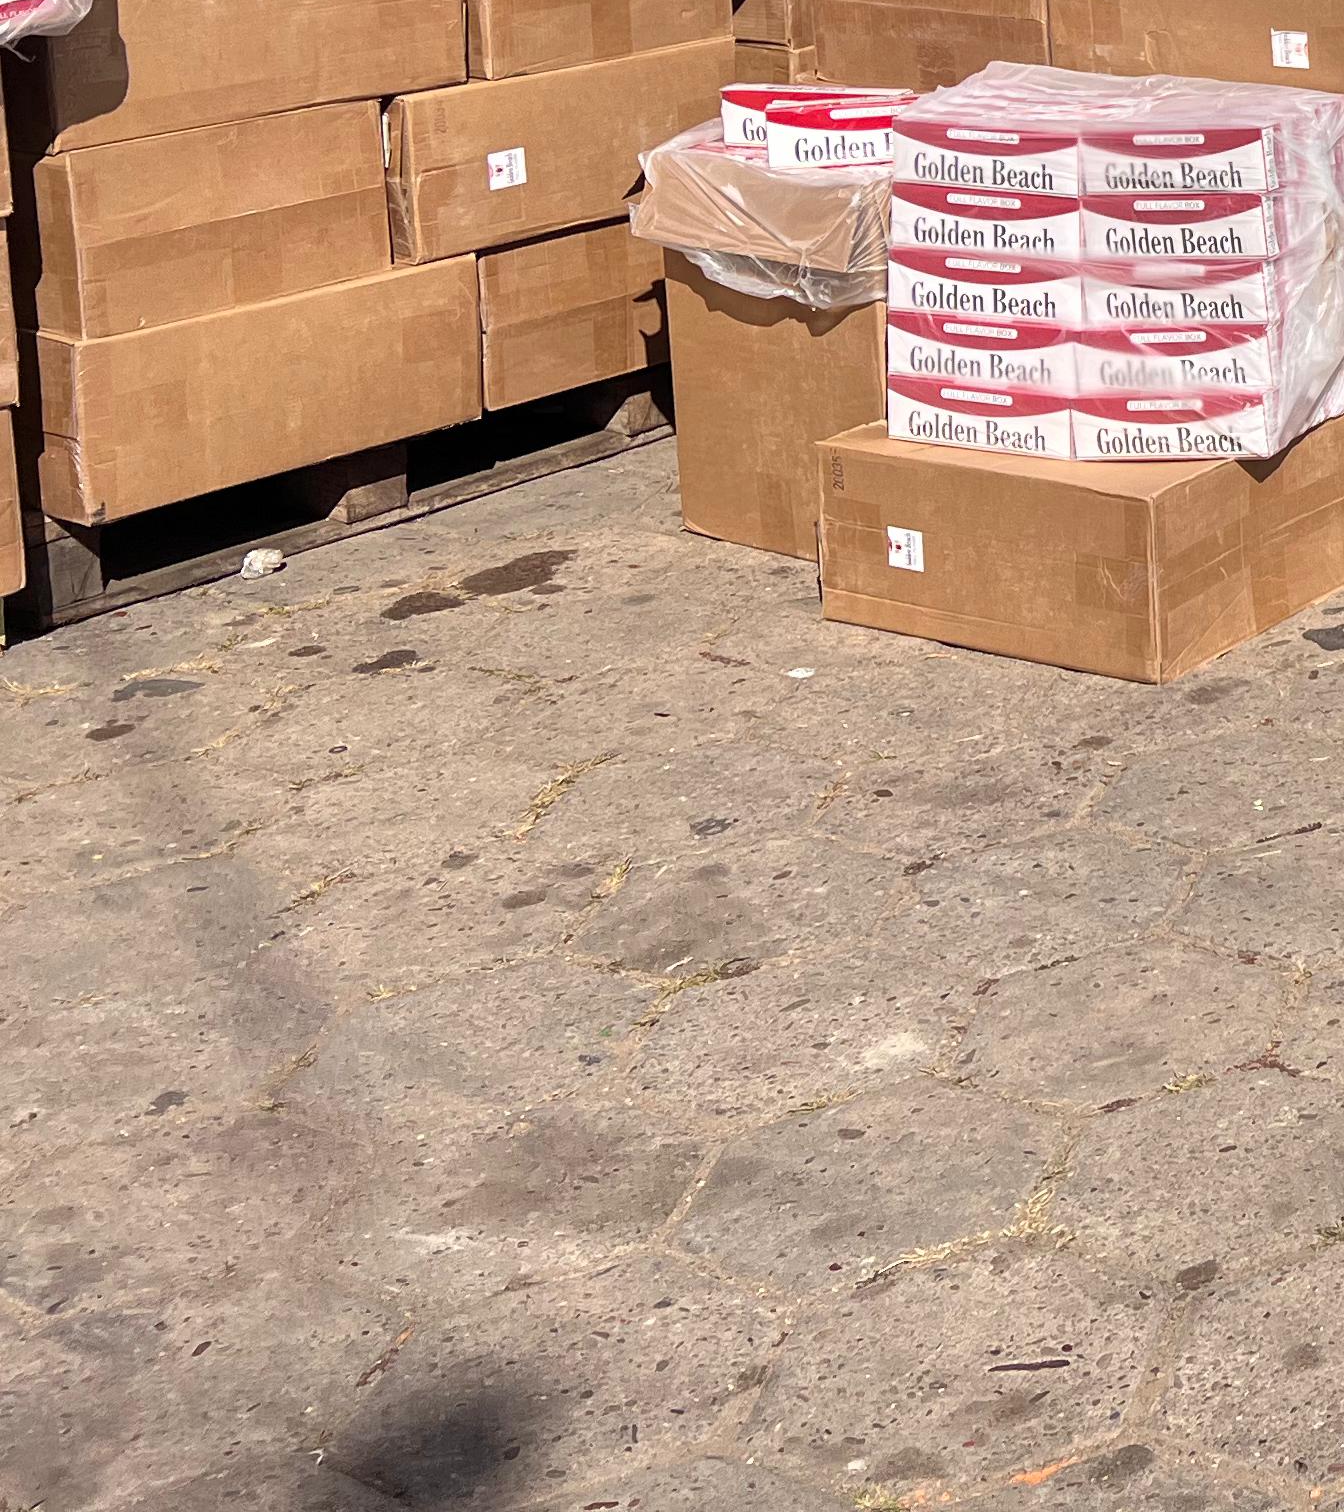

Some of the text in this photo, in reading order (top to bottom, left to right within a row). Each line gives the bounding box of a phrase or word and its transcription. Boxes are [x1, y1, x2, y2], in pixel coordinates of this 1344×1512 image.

[795, 135, 876, 162] Golden
[914, 153, 1053, 190] Golden Beach
[1106, 228, 1243, 254] Golden Beach
[912, 283, 1056, 318] Golden Beach
[1106, 293, 1244, 319] Golden Beach
[909, 411, 1045, 451] Golden Beach
[1097, 428, 1242, 454] Golden Beach
